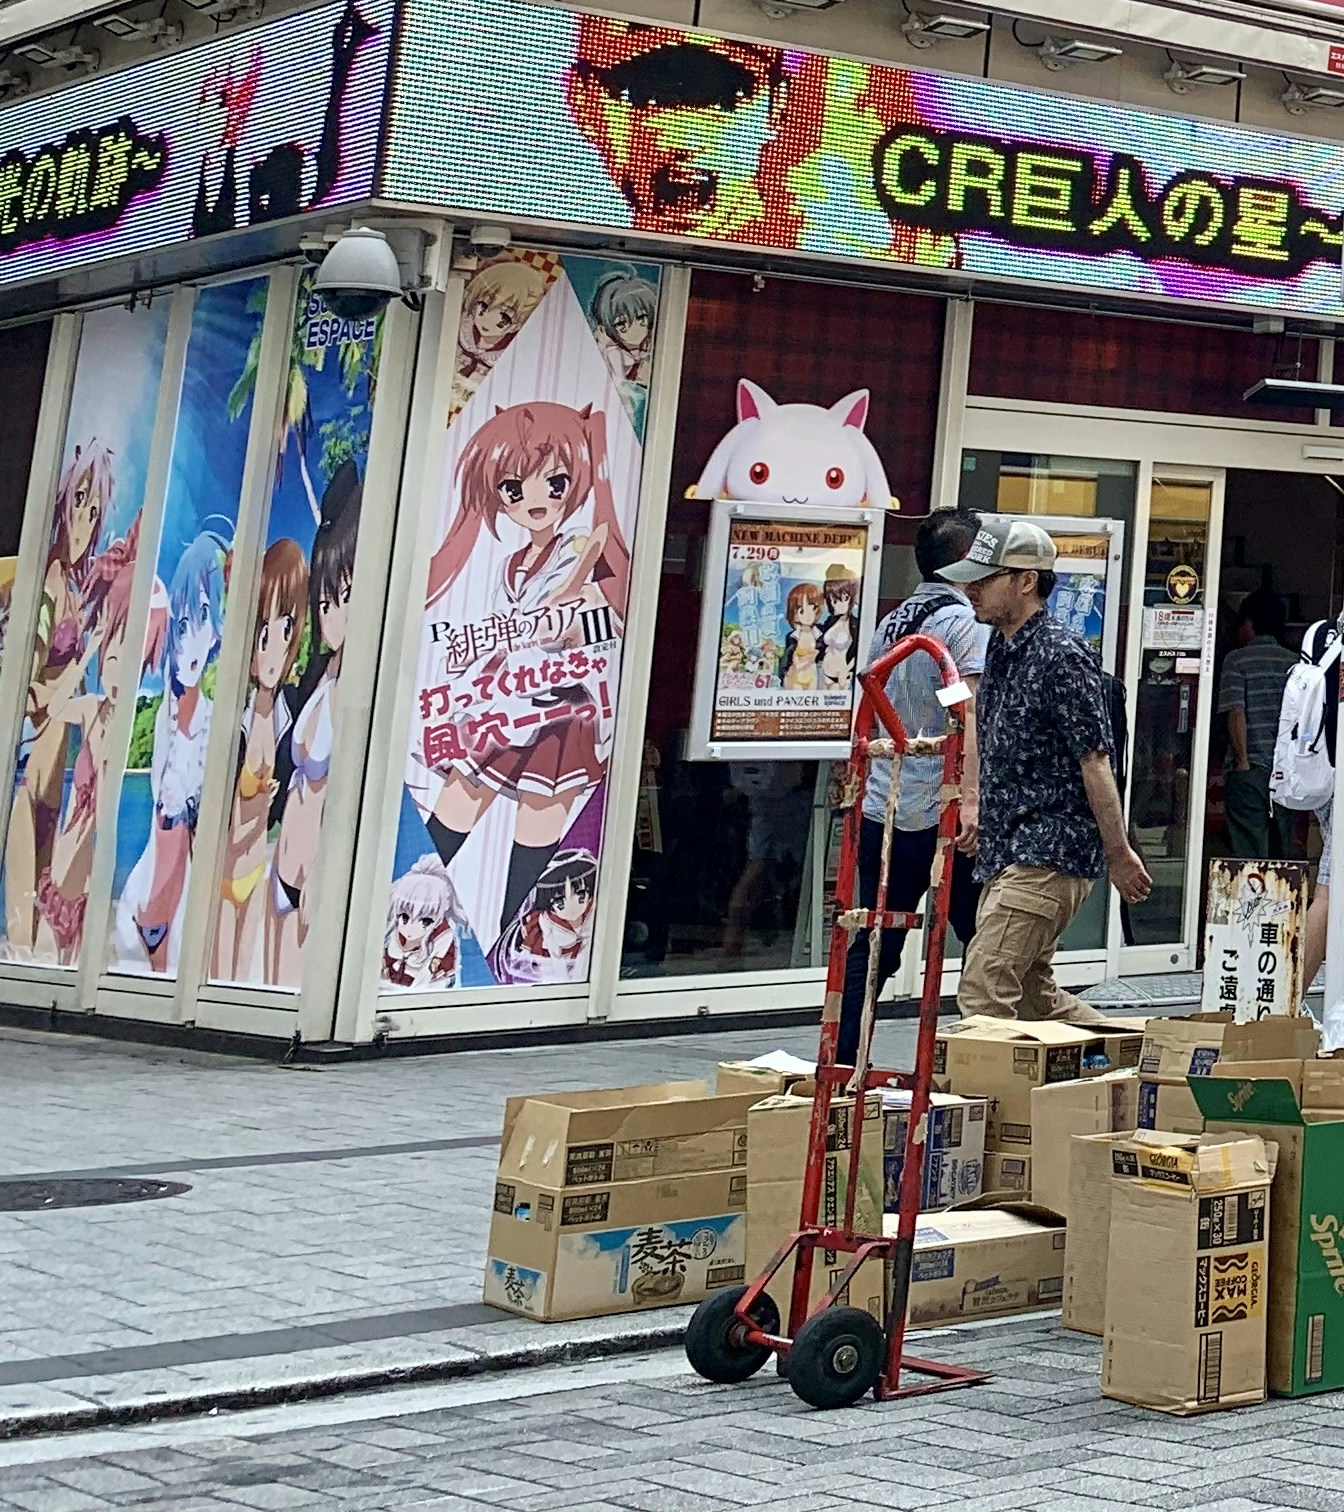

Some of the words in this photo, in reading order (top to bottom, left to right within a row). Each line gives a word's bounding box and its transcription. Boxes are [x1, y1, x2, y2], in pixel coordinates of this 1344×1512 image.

[306, 318, 376, 350] ESPACE
[418, 650, 608, 720] 打ってくれなきゃ
[718, 694, 751, 707] GIRLS
[776, 694, 820, 706] PANZER
[629, 1225, 694, 1278] 麦茶
